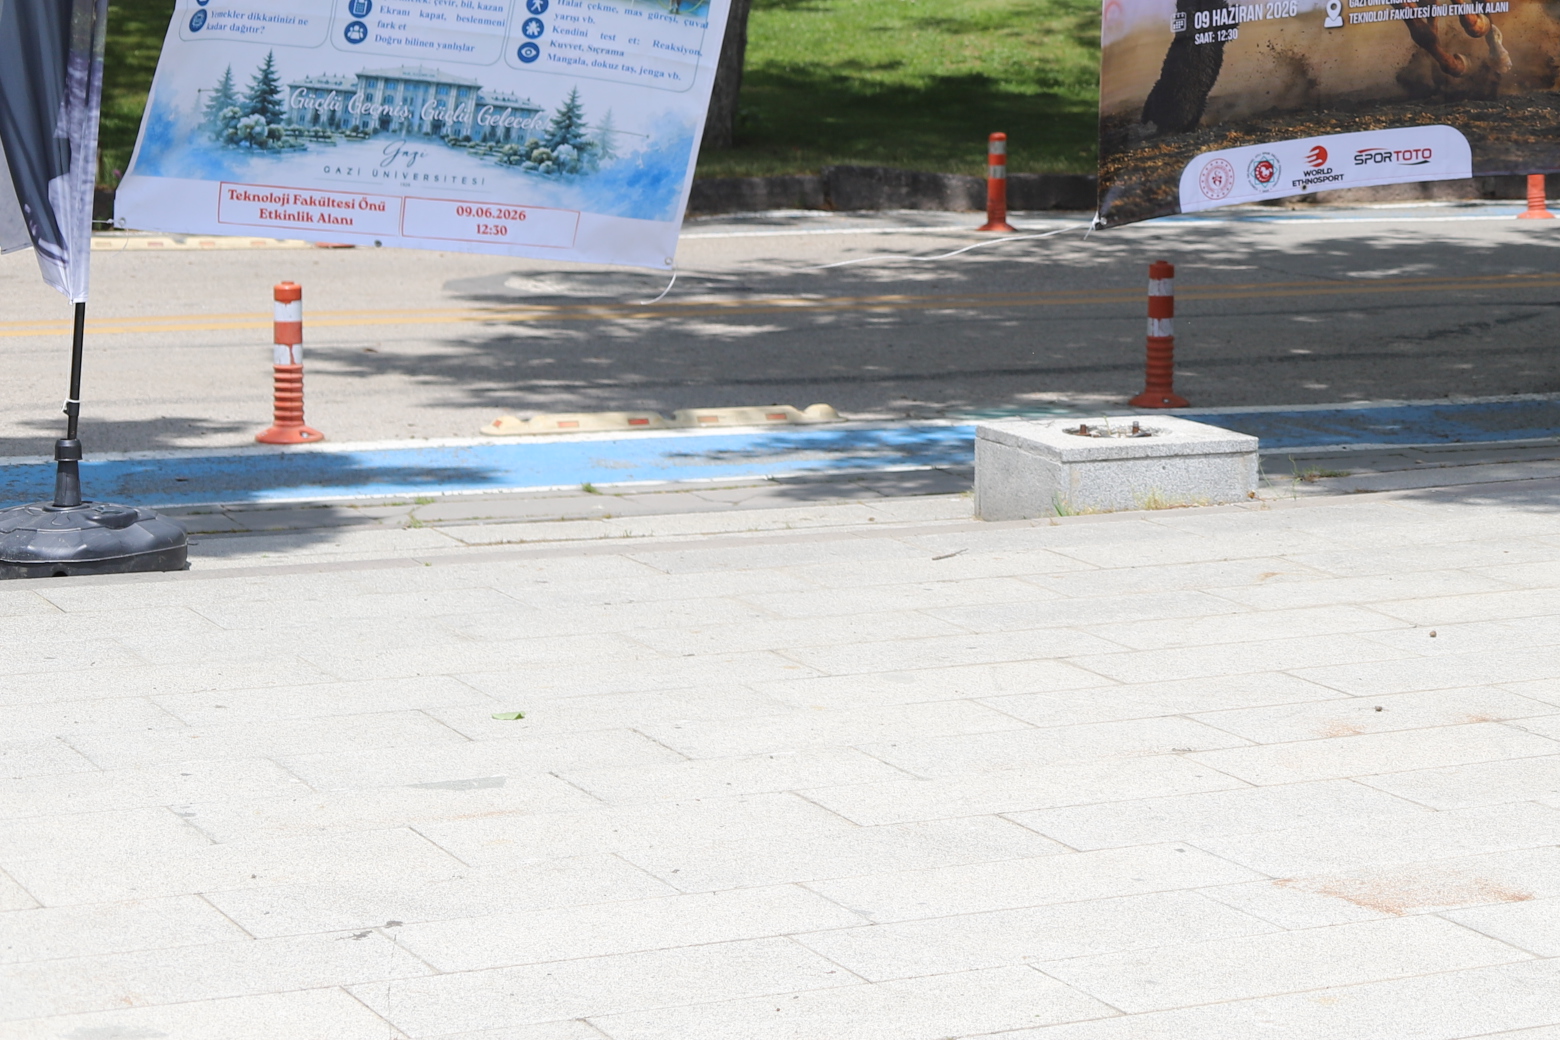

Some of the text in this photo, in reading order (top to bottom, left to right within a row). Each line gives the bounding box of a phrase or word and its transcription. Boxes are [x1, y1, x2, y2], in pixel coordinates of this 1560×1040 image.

[461, 0, 474, 9] bil,
[477, 2, 503, 12] kazan
[1349, 2, 1508, 24] TEKNOLOJİ FAKÜLTESİ ÖNÜ ETKİNLİK ALANI
[247, 12, 295, 24] dikkatinizi
[380, 6, 505, 27] Ekranı kapat, beslenmeni
[554, 13, 579, 22] yarışı
[624, 8, 642, 16] mas
[684, 18, 708, 29] çuval
[1194, 0, 1297, 29] 09 HAZİRAN 2026
[377, 20, 395, 29] fark
[552, 25, 588, 37] Kendini
[600, 32, 616, 41] test
[1195, 29, 1238, 45] SAAT: 12:30
[375, 34, 475, 52] Doğru bilinen yanlışlar
[588, 45, 624, 57] Sıçrama
[591, 60, 619, 70] dokuz
[638, 67, 664, 78] jenga
[668, 71, 681, 80] vb.
[290, 87, 342, 114] Güçlü
[420, 100, 471, 130] Güçlü
[372, 168, 486, 186] ÜNİVERSİTESİ
[1292, 174, 1345, 187] ETHNOSPORT
[1303, 168, 1333, 177] WORLD
[228, 188, 386, 212] Teknoloji Fakültesi Önü
[259, 208, 354, 226] Etkinlik Alanı
[456, 206, 527, 221] 09.06.2026
[476, 223, 508, 237] 12:30
